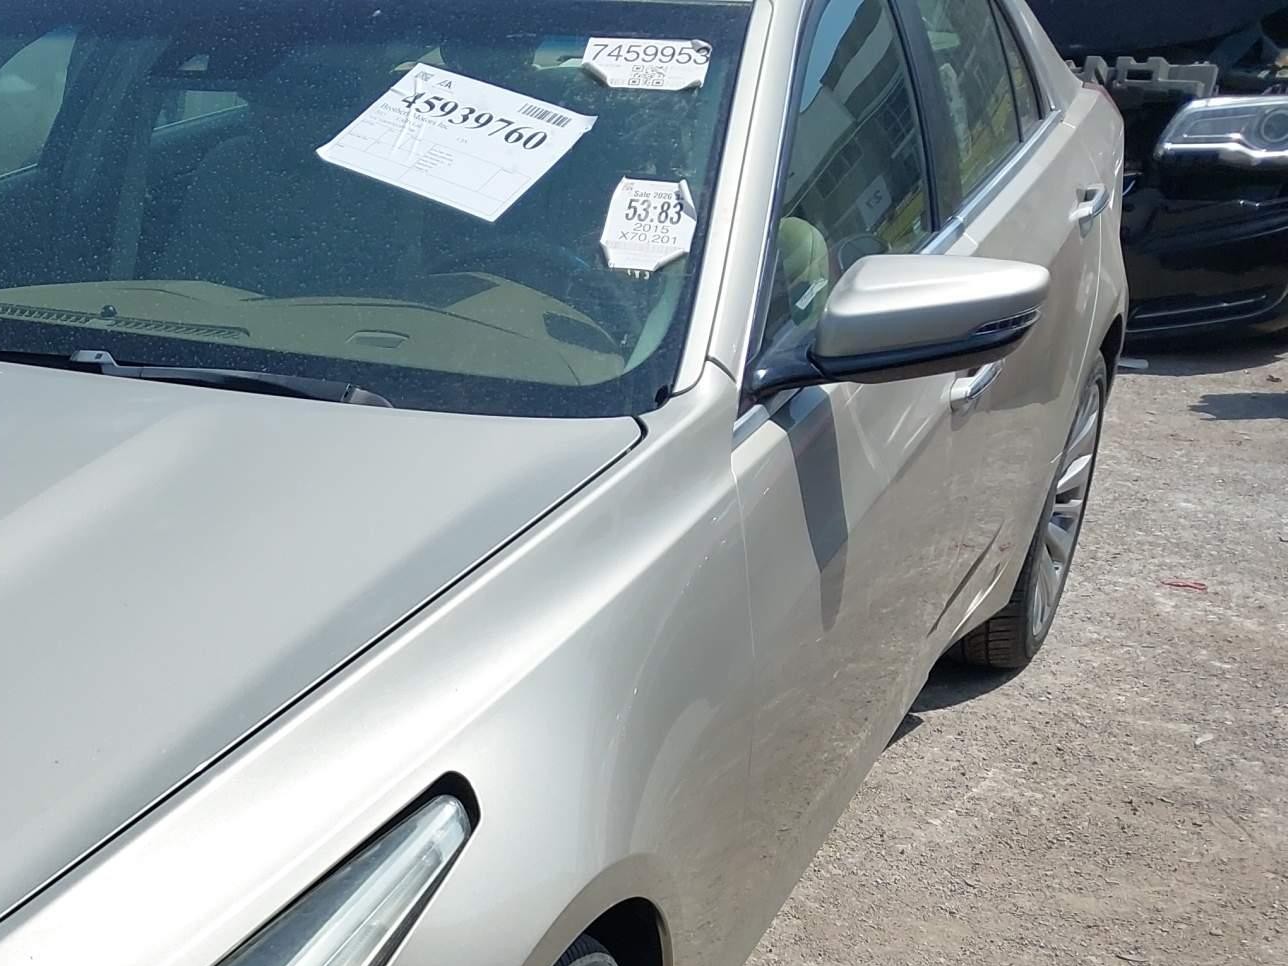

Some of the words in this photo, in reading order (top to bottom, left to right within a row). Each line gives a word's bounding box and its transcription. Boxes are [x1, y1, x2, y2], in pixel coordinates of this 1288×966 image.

[592, 43, 710, 65] 7459953
[402, 91, 548, 150] 45939760
[625, 198, 683, 225] 53:83
[632, 222, 671, 234] 2015
